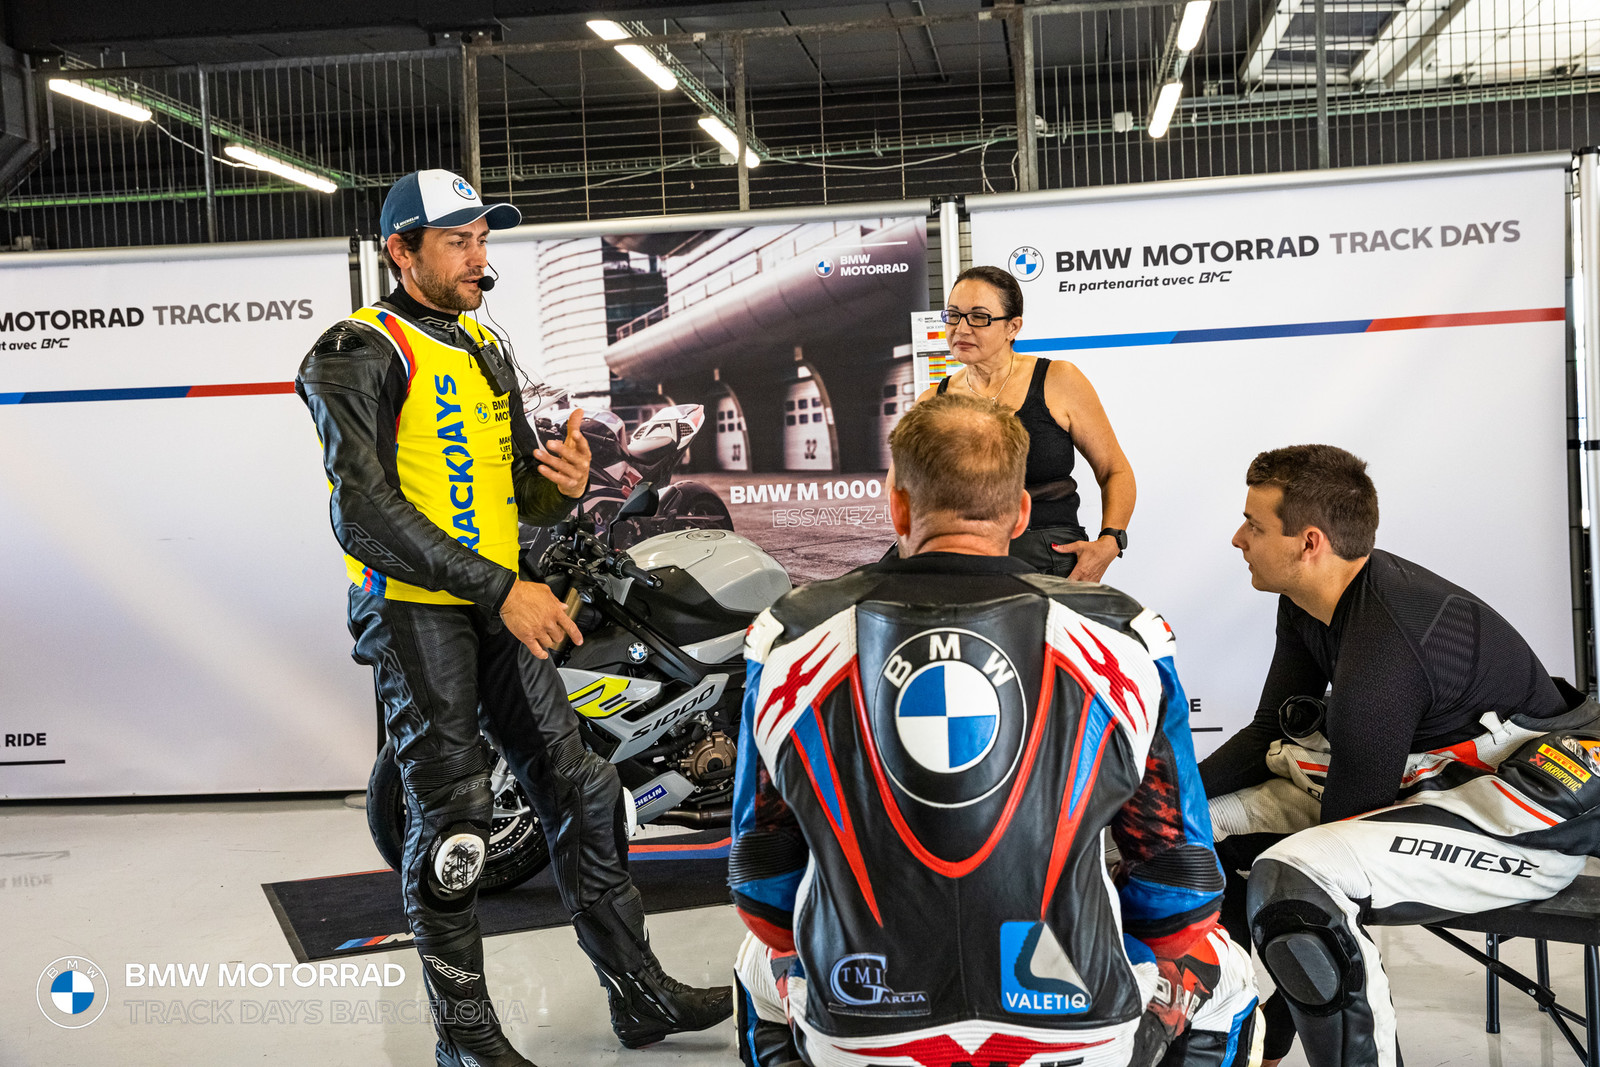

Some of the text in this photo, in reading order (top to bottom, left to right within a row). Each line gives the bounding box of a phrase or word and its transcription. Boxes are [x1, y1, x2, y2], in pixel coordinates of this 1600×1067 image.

[1056, 219, 1521, 273] BMW MOTORRAD TRACK DAYS
[840, 254, 871, 264] BMW
[840, 263, 909, 276] MOTORRAD
[1059, 270, 1233, 294] En partenariat avec BMC
[0, 299, 314, 332] MOTORRAD TRACK DAYS
[9, 342, 38, 351] avec
[41, 337, 70, 349] BMC
[434, 374, 480, 553] RACKDAYS
[730, 479, 882, 504] BMW M 1000
[772, 504, 893, 528] ESSAYEZ-L
[884, 633, 1016, 689] BMW
[5, 733, 47, 747] RIDE
[634, 787, 663, 808] CHELIN
[1389, 836, 1540, 878] DAINESE
[1006, 991, 1086, 1010] VALETIQ
